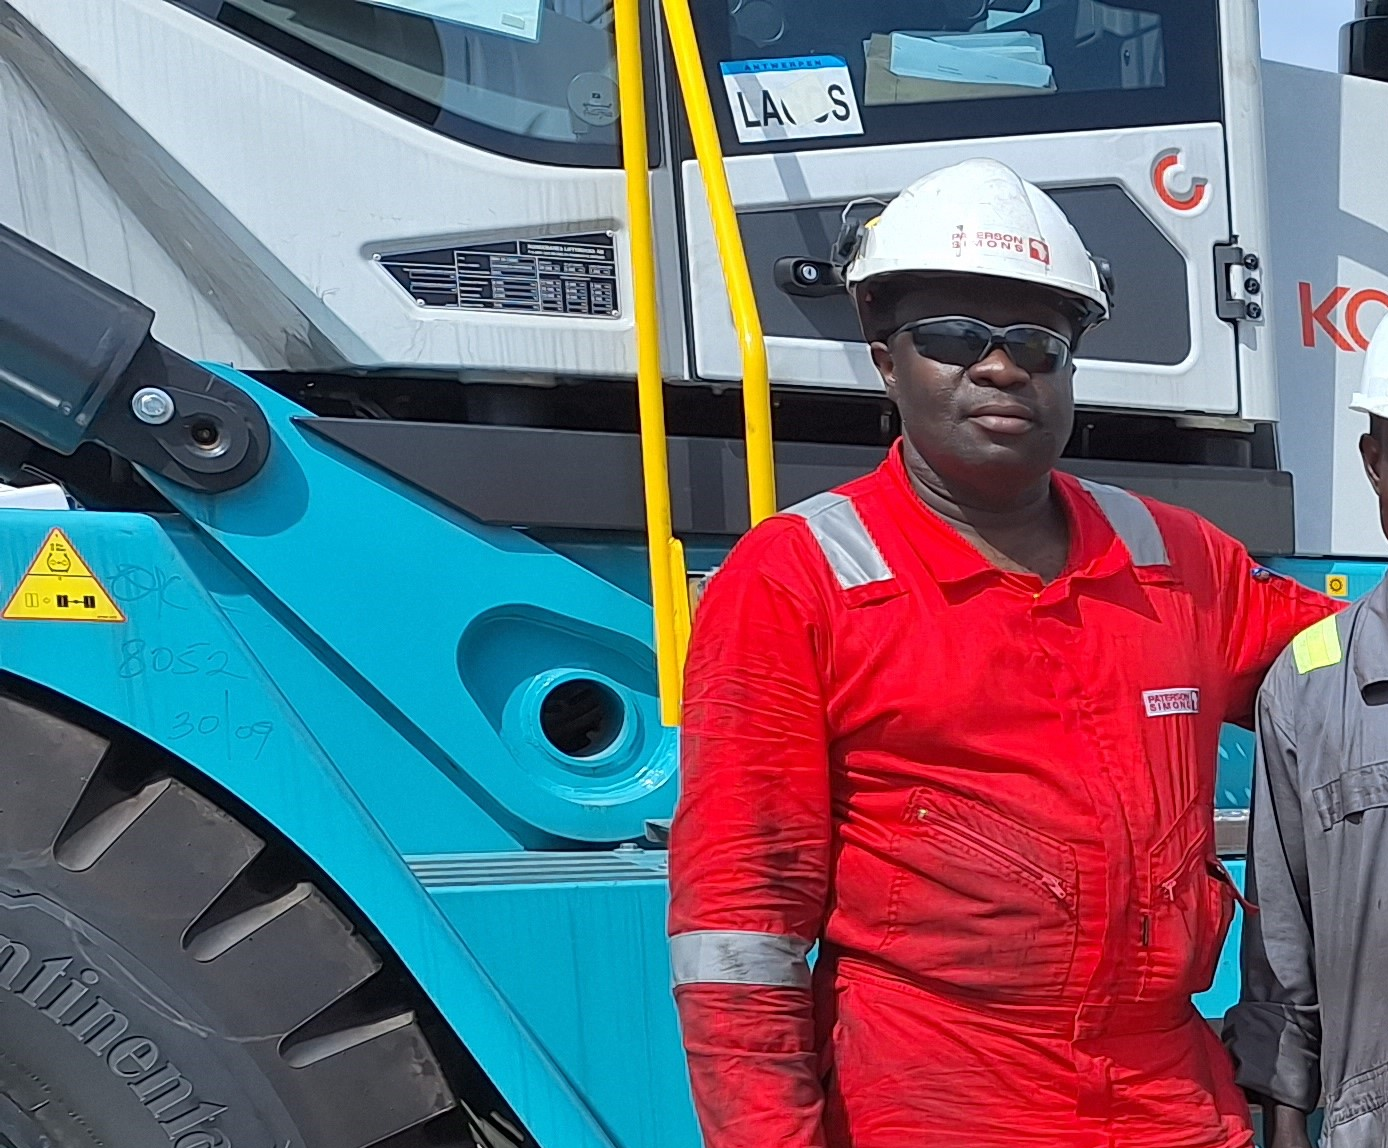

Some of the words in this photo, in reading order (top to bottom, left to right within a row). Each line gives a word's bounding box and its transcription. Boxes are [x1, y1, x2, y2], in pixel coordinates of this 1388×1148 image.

[744, 60, 822, 71] ANTWERPEN
[737, 84, 850, 128] LAS
[119, 638, 247, 679] 8052
[1148, 693, 1189, 704] PATERSON
[168, 690, 273, 760] 30/09
